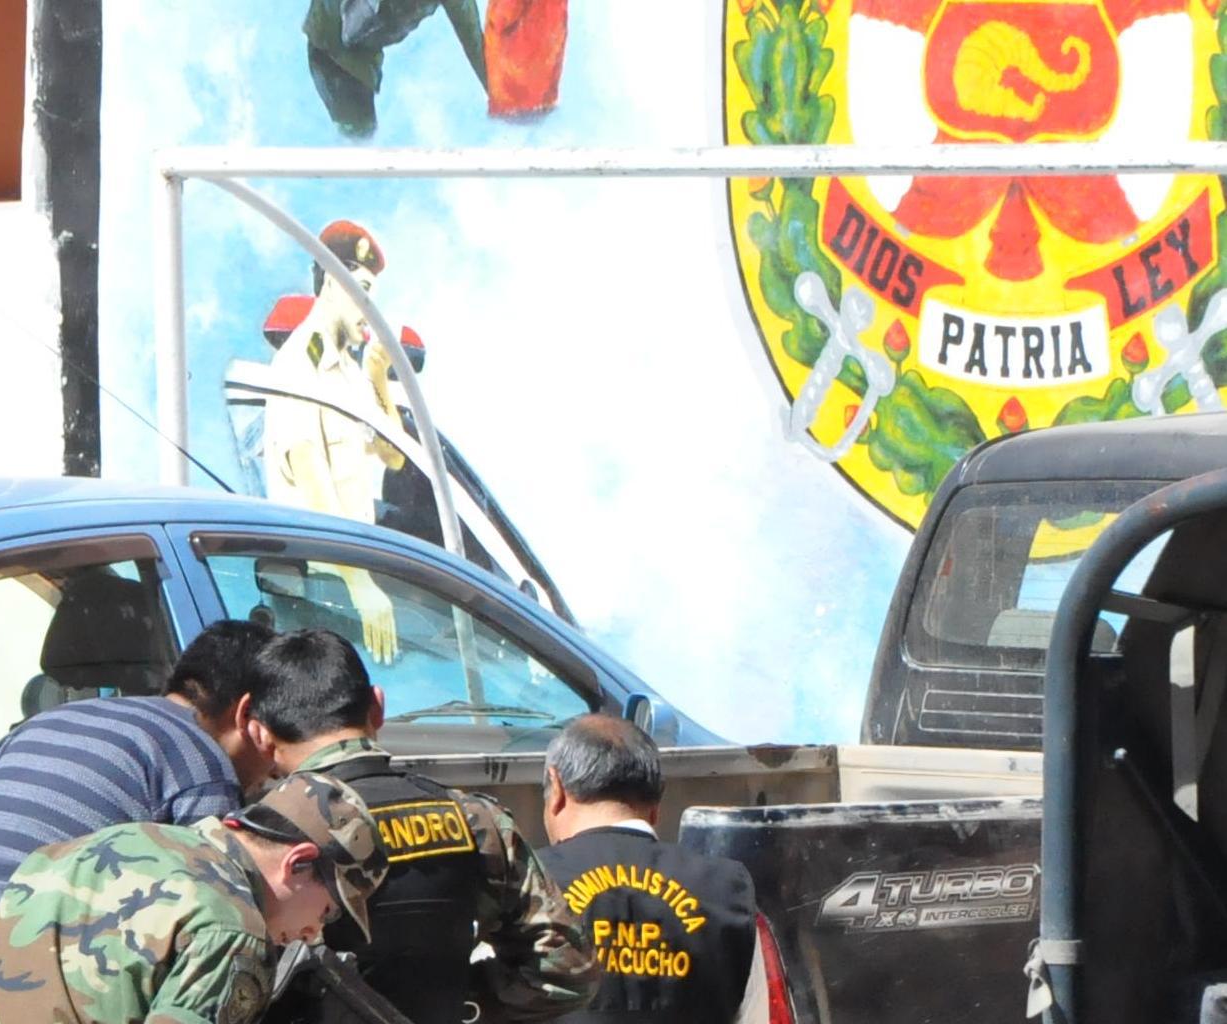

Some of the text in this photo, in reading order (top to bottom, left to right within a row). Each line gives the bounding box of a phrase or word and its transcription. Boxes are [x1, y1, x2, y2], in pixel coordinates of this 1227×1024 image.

[829, 202, 925, 308] DIOS
[1113, 219, 1200, 318] LEY
[937, 312, 1094, 379] PATRIA
[378, 811, 463, 849] ANDRO
[563, 864, 707, 934] RIMINALISTICA
[593, 919, 668, 949] P.N.P.
